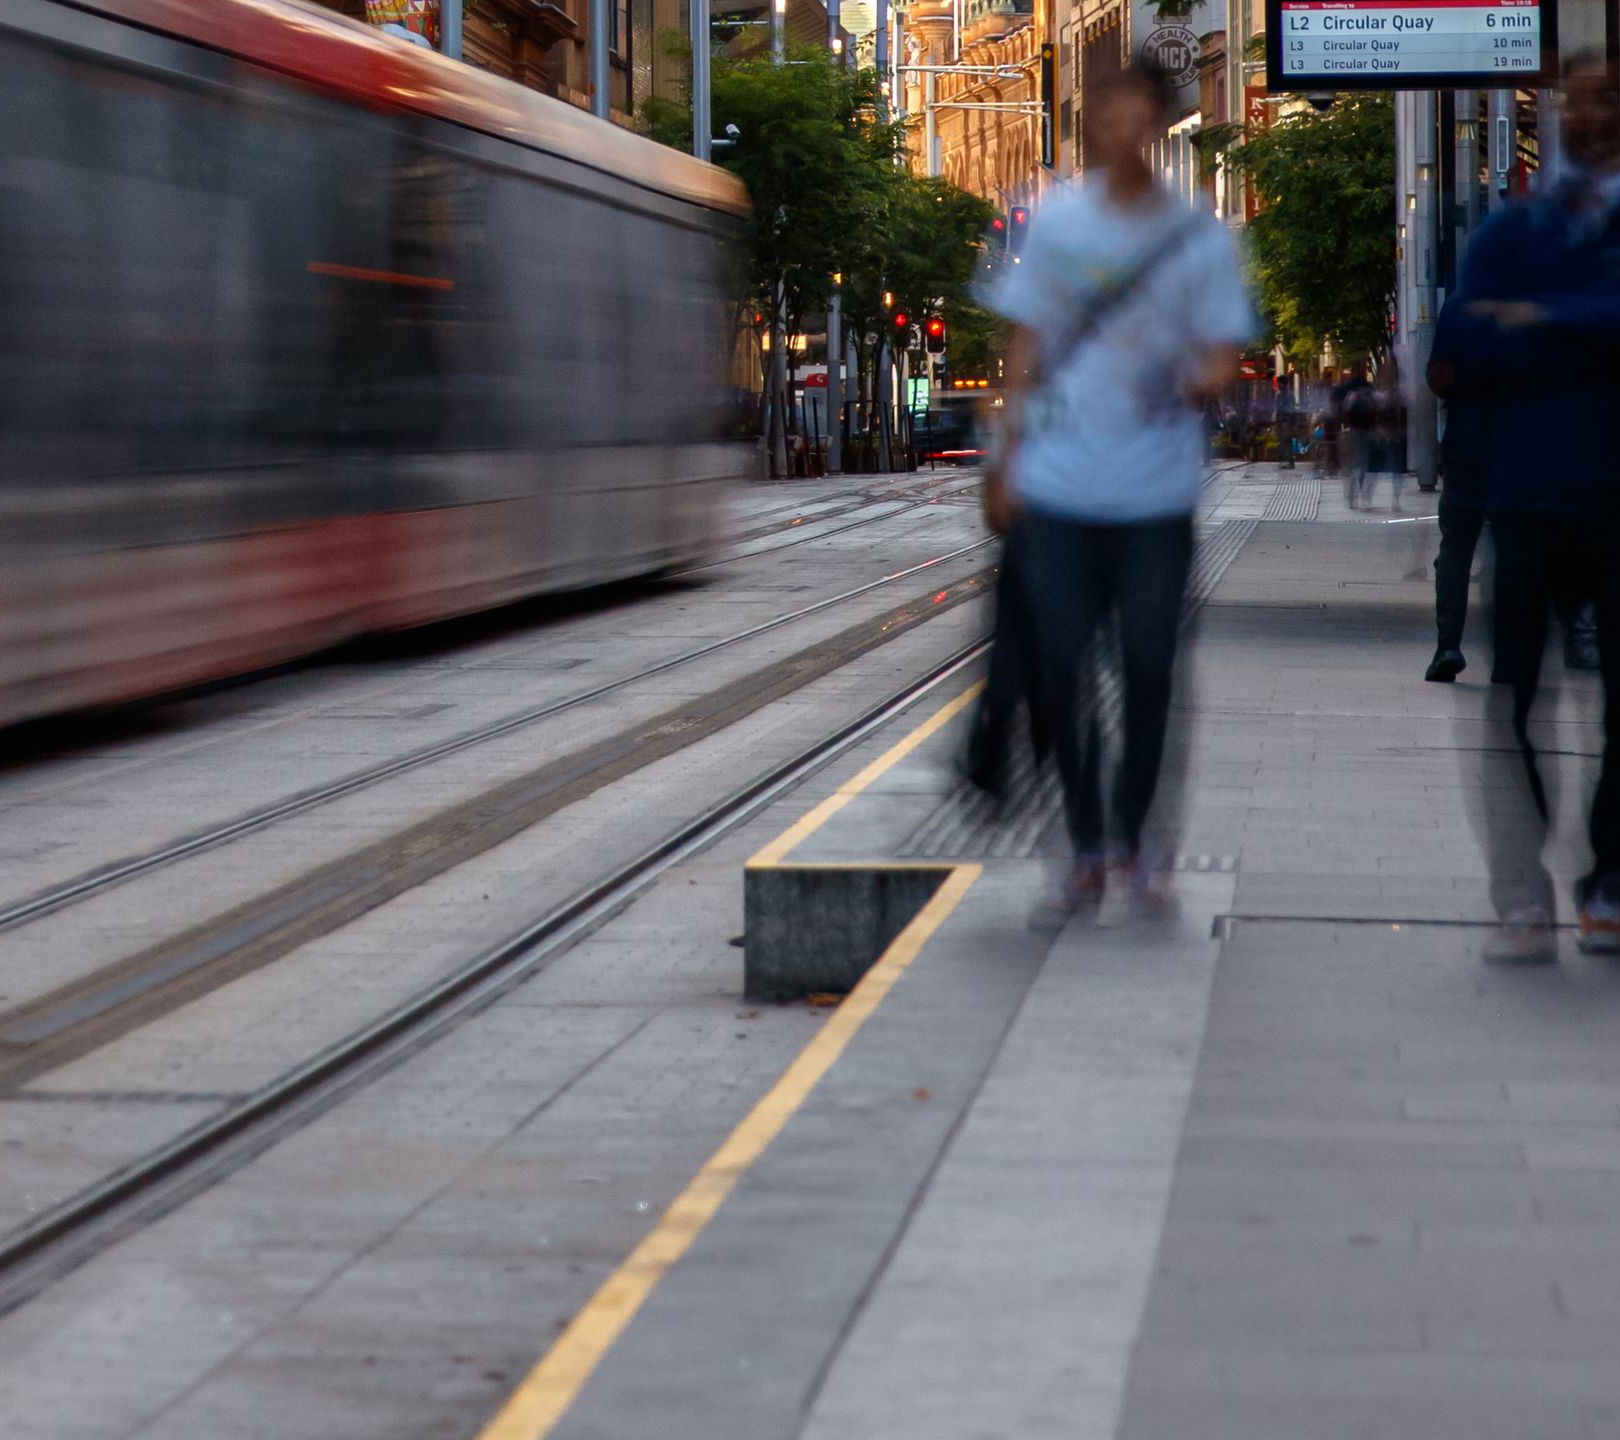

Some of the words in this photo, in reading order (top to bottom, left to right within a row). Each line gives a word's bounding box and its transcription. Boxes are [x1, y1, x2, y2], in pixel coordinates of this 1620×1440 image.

[1290, 16, 1310, 31] L2
[1323, 14, 1387, 31] Circular
[1392, 14, 1434, 32] Quay
[1486, 13, 1496, 28] 6
[1502, 12, 1532, 28] min
[1152, 30, 1192, 44] HEALTH
[1290, 40, 1304, 51] L3
[1323, 40, 1367, 52] Circular
[1371, 39, 1400, 52] Quay
[1493, 38, 1508, 49] 10
[1512, 37, 1533, 49] min
[1158, 46, 1187, 69] HCF
[1290, 59, 1305, 71] L3
[1323, 58, 1367, 71] Circular
[1371, 58, 1401, 71] Quay
[1493, 57, 1508, 68] 19
[1512, 56, 1533, 68] min
